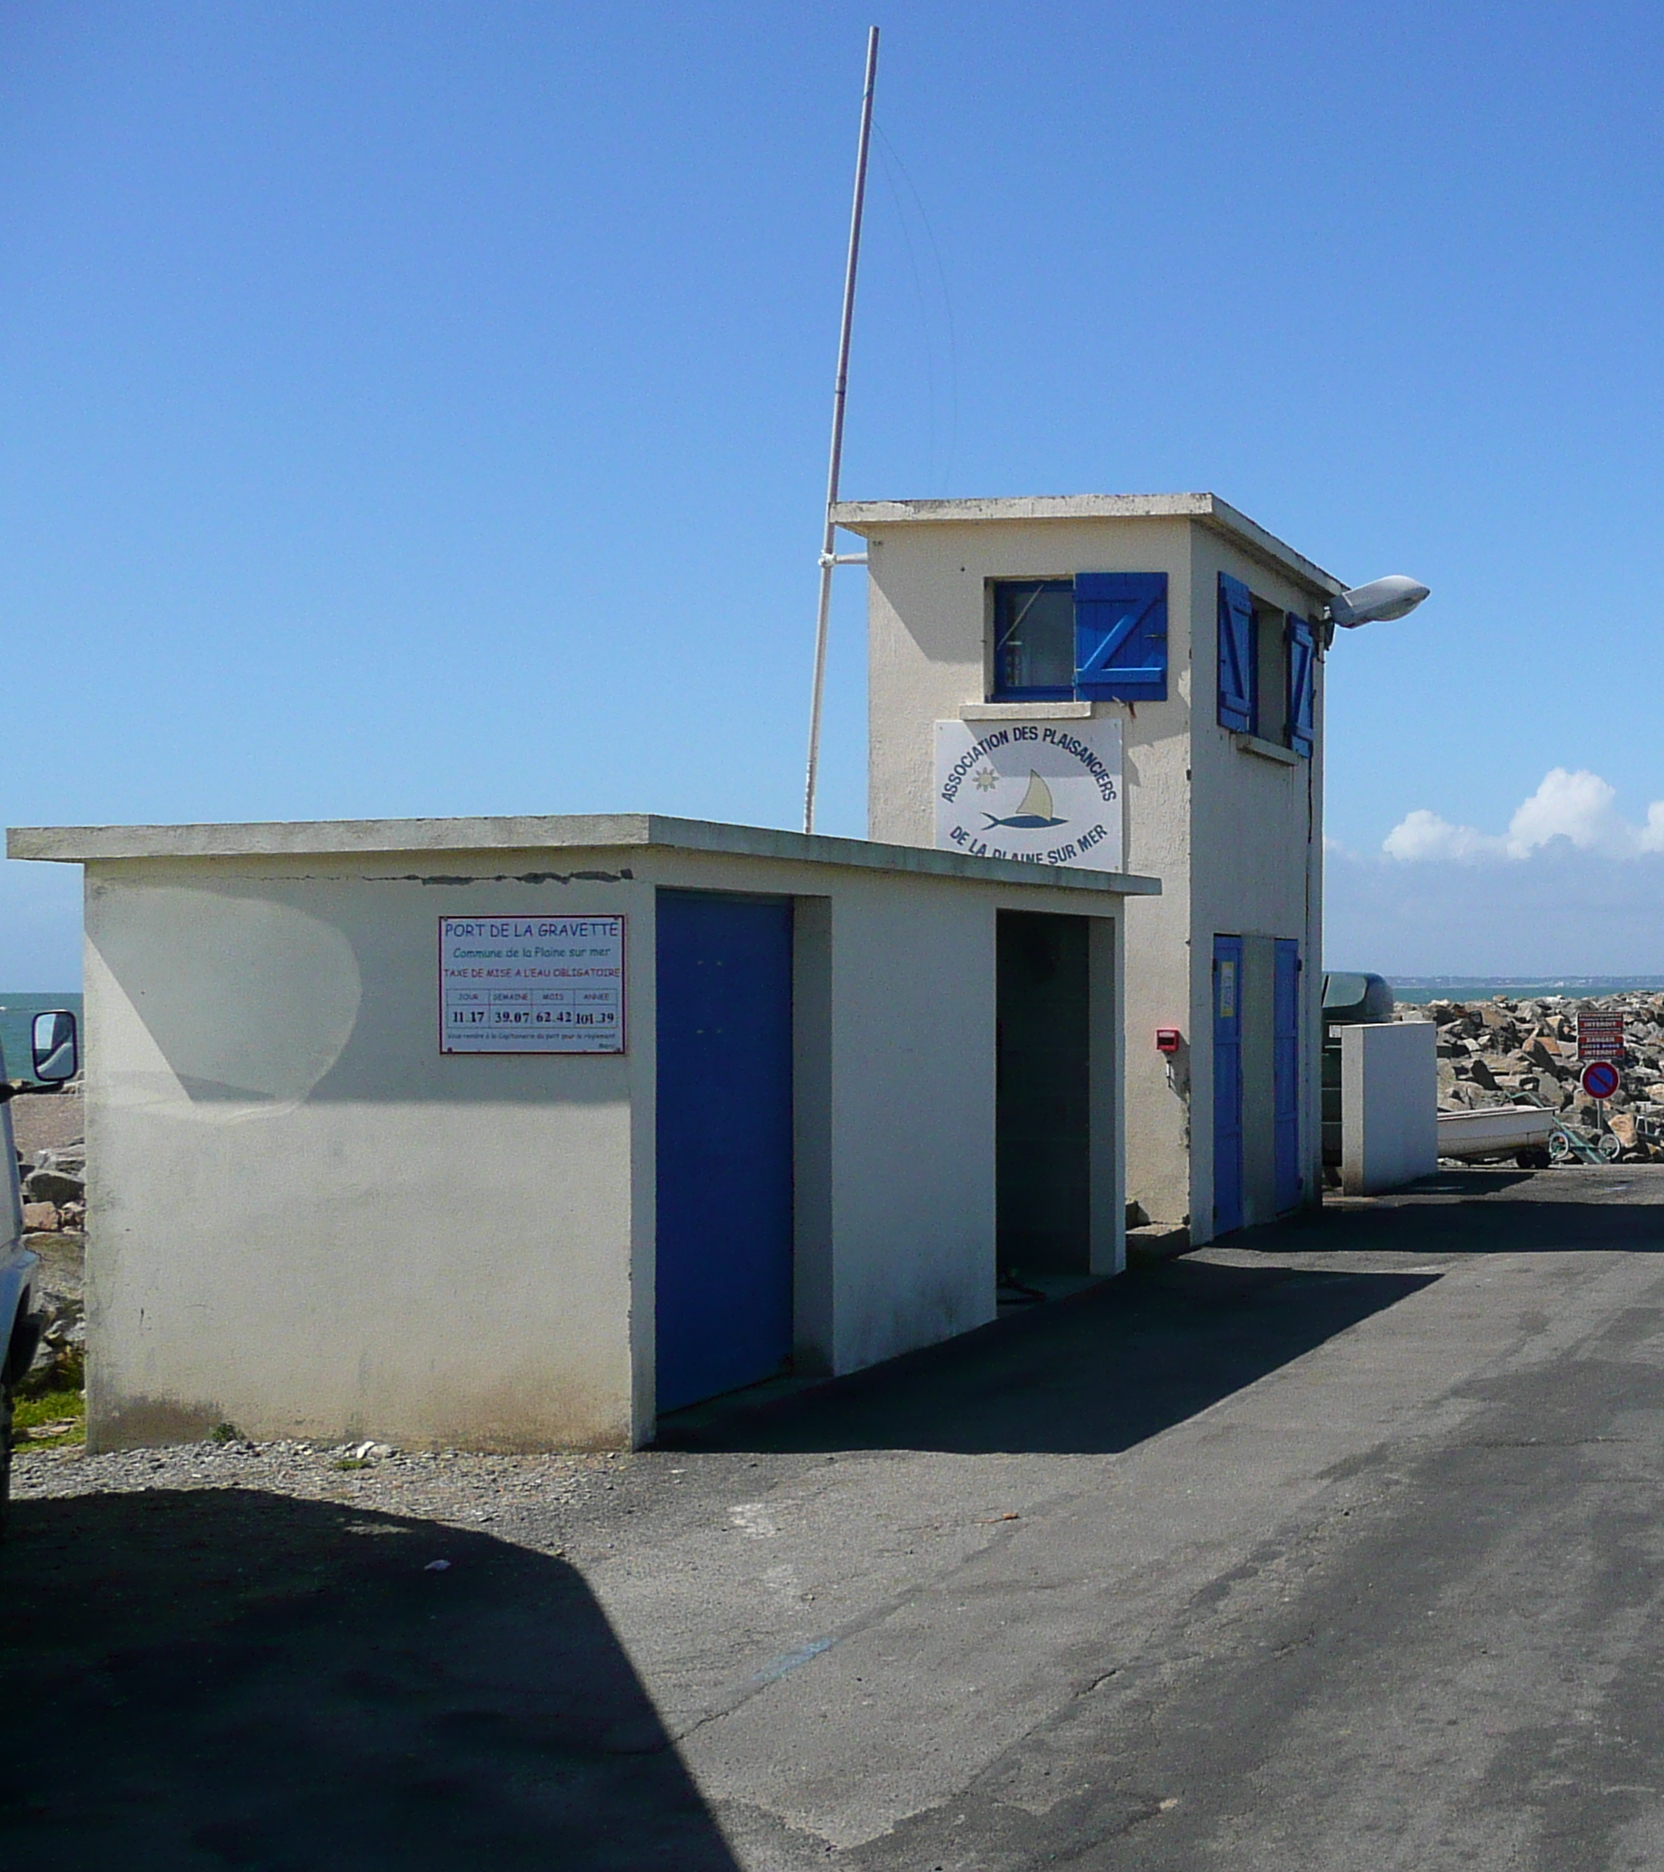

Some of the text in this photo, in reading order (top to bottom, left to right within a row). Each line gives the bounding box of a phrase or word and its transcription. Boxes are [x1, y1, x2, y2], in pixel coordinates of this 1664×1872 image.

[941, 725, 1117, 804] ASSOCIATION DES PLAISANCIERS
[949, 825, 970, 846] DE
[968, 838, 987, 858] LA
[1046, 843, 1077, 866] SUR
[1076, 823, 1108, 852] MER
[445, 922, 618, 938] PORT DE LA GRAVETTE
[453, 946, 611, 958] Commune de la Plaine sur mer
[444, 967, 621, 978] TAXE DE MISE A L'EAU OBLIGATOIRE
[458, 993, 479, 1001] JOUR
[493, 993, 529, 1001] SEMAINE
[542, 993, 564, 1001] MOIS
[495, 1012, 530, 1024] 39.07
